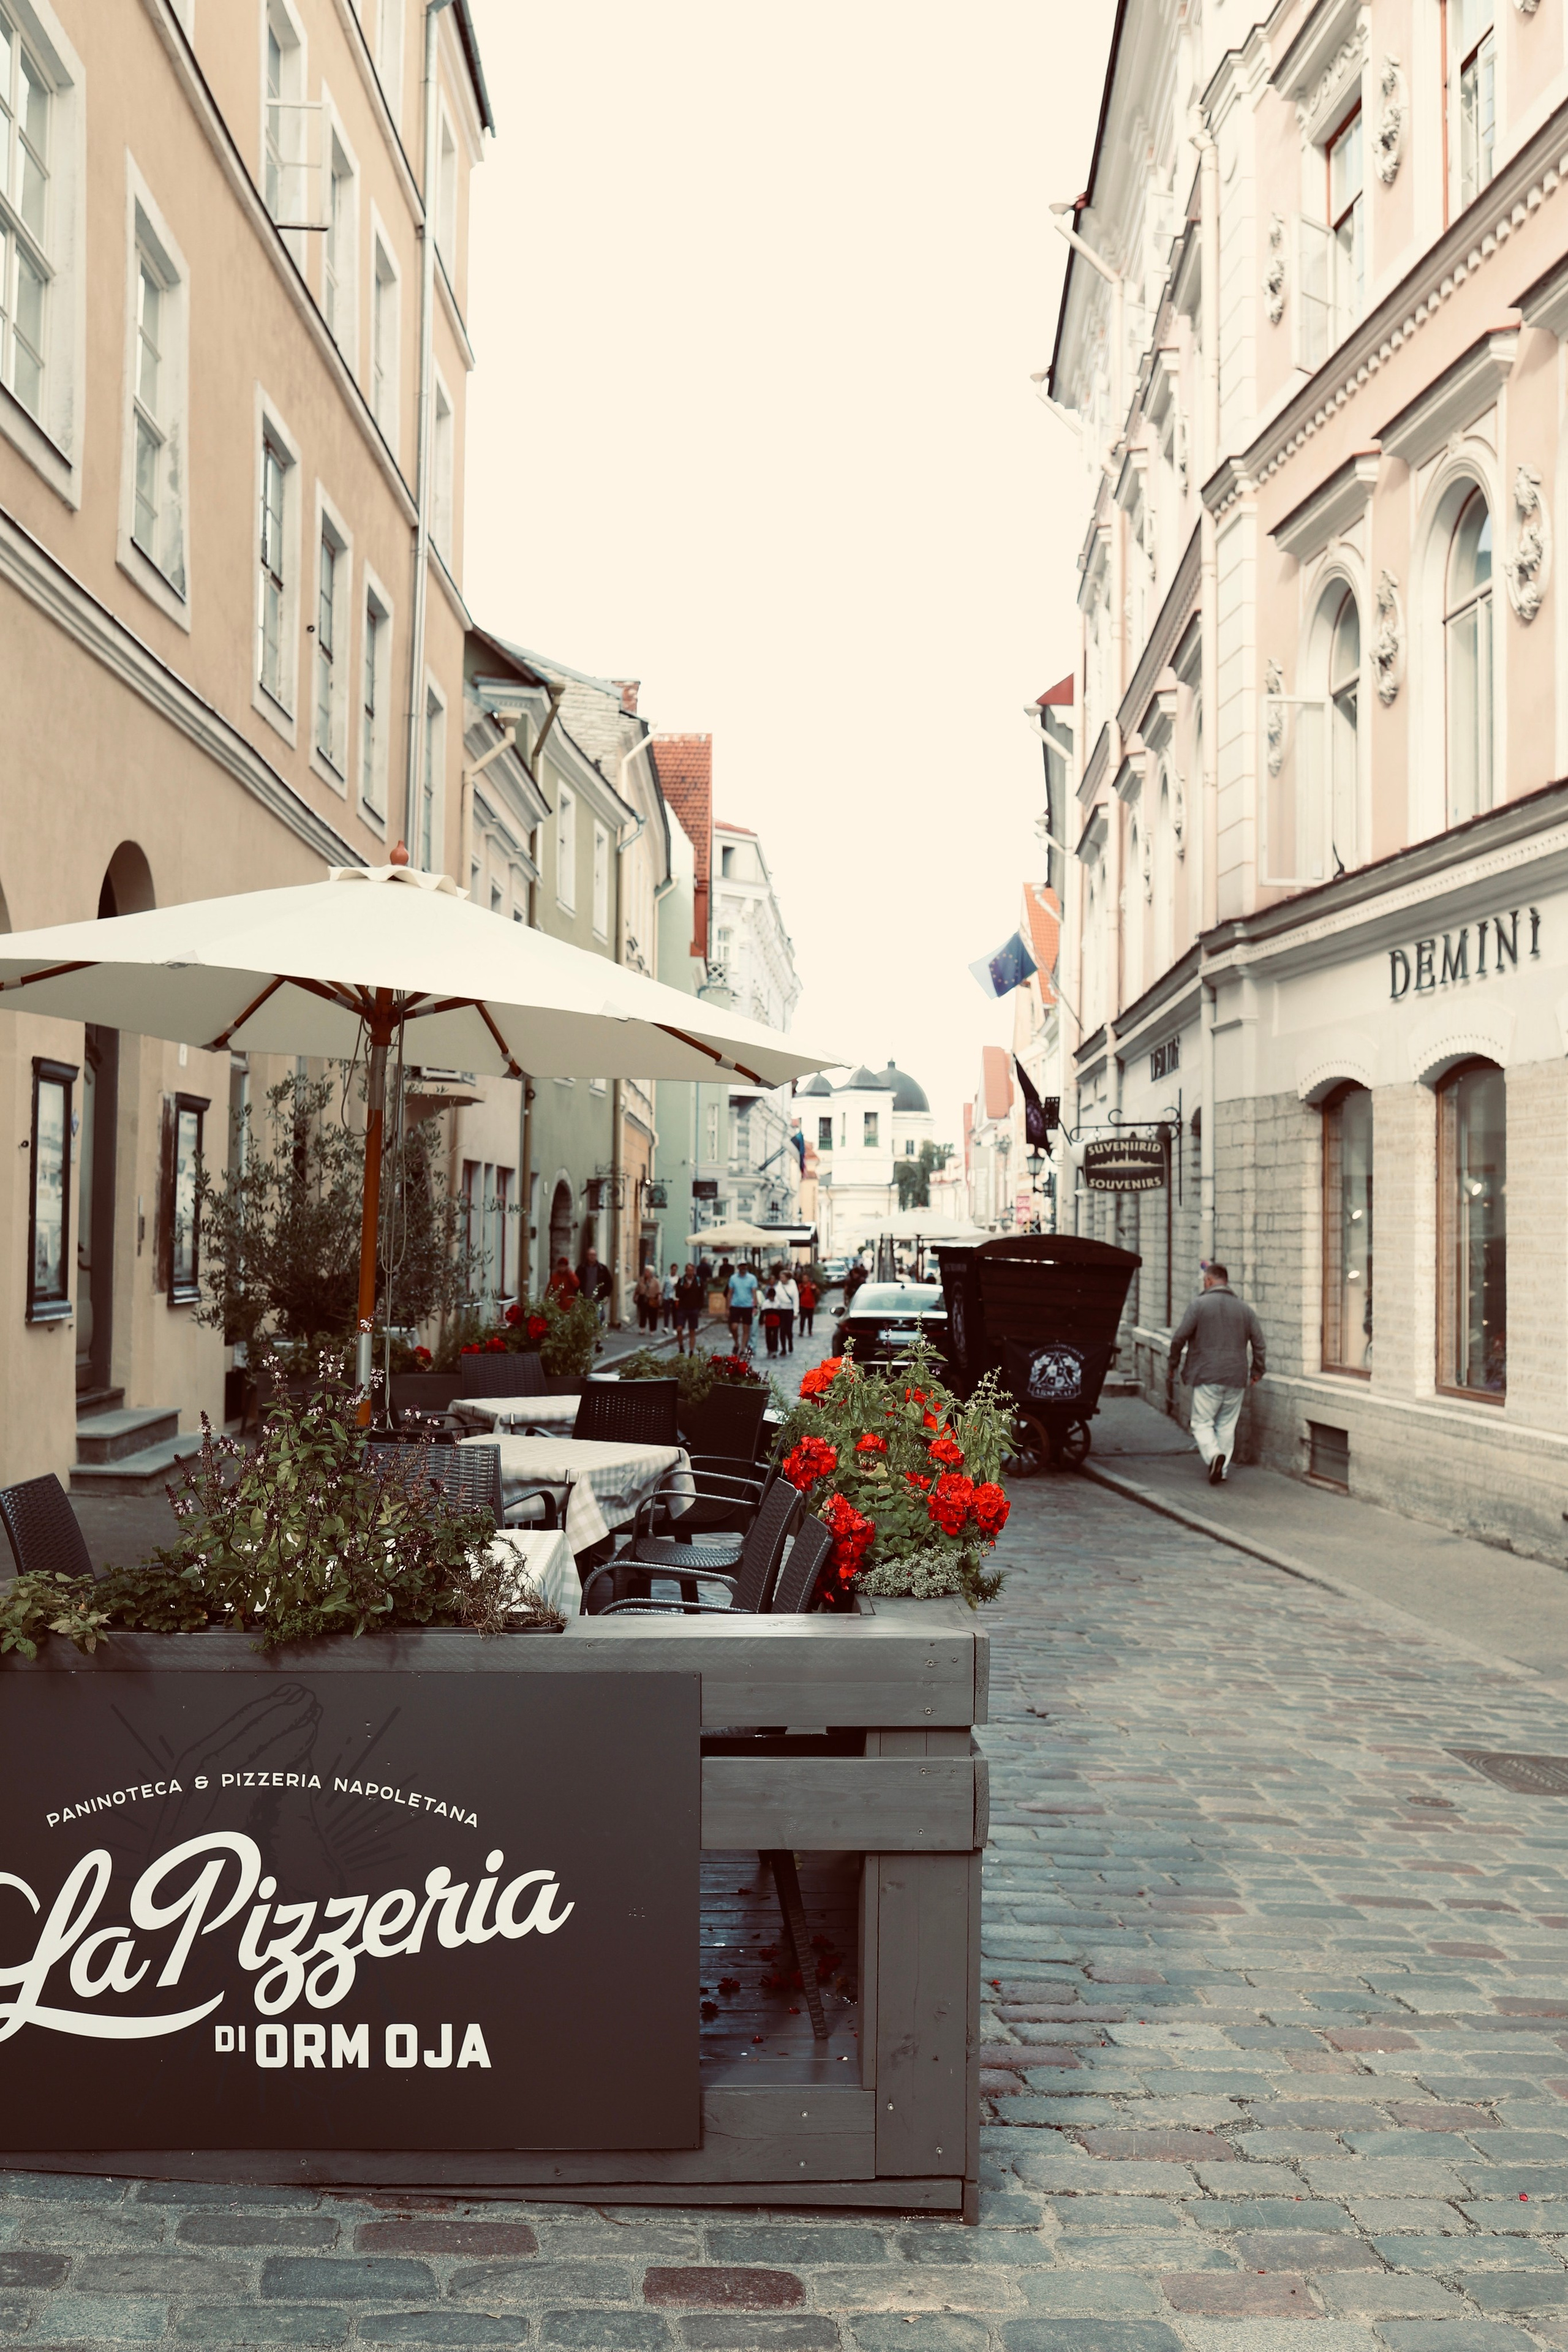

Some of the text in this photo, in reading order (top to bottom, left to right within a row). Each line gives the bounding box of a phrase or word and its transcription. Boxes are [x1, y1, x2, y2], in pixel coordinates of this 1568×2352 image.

[1087, 1140, 1162, 1156] SUVENIIRID
[1088, 1176, 1162, 1189] SOUVENIRS
[46, 1772, 480, 1828] PANINOTECA & PIZZERIA NAPOLETANA
[0, 1831, 576, 2043] La Pizzeria
[215, 2026, 246, 2052] DI
